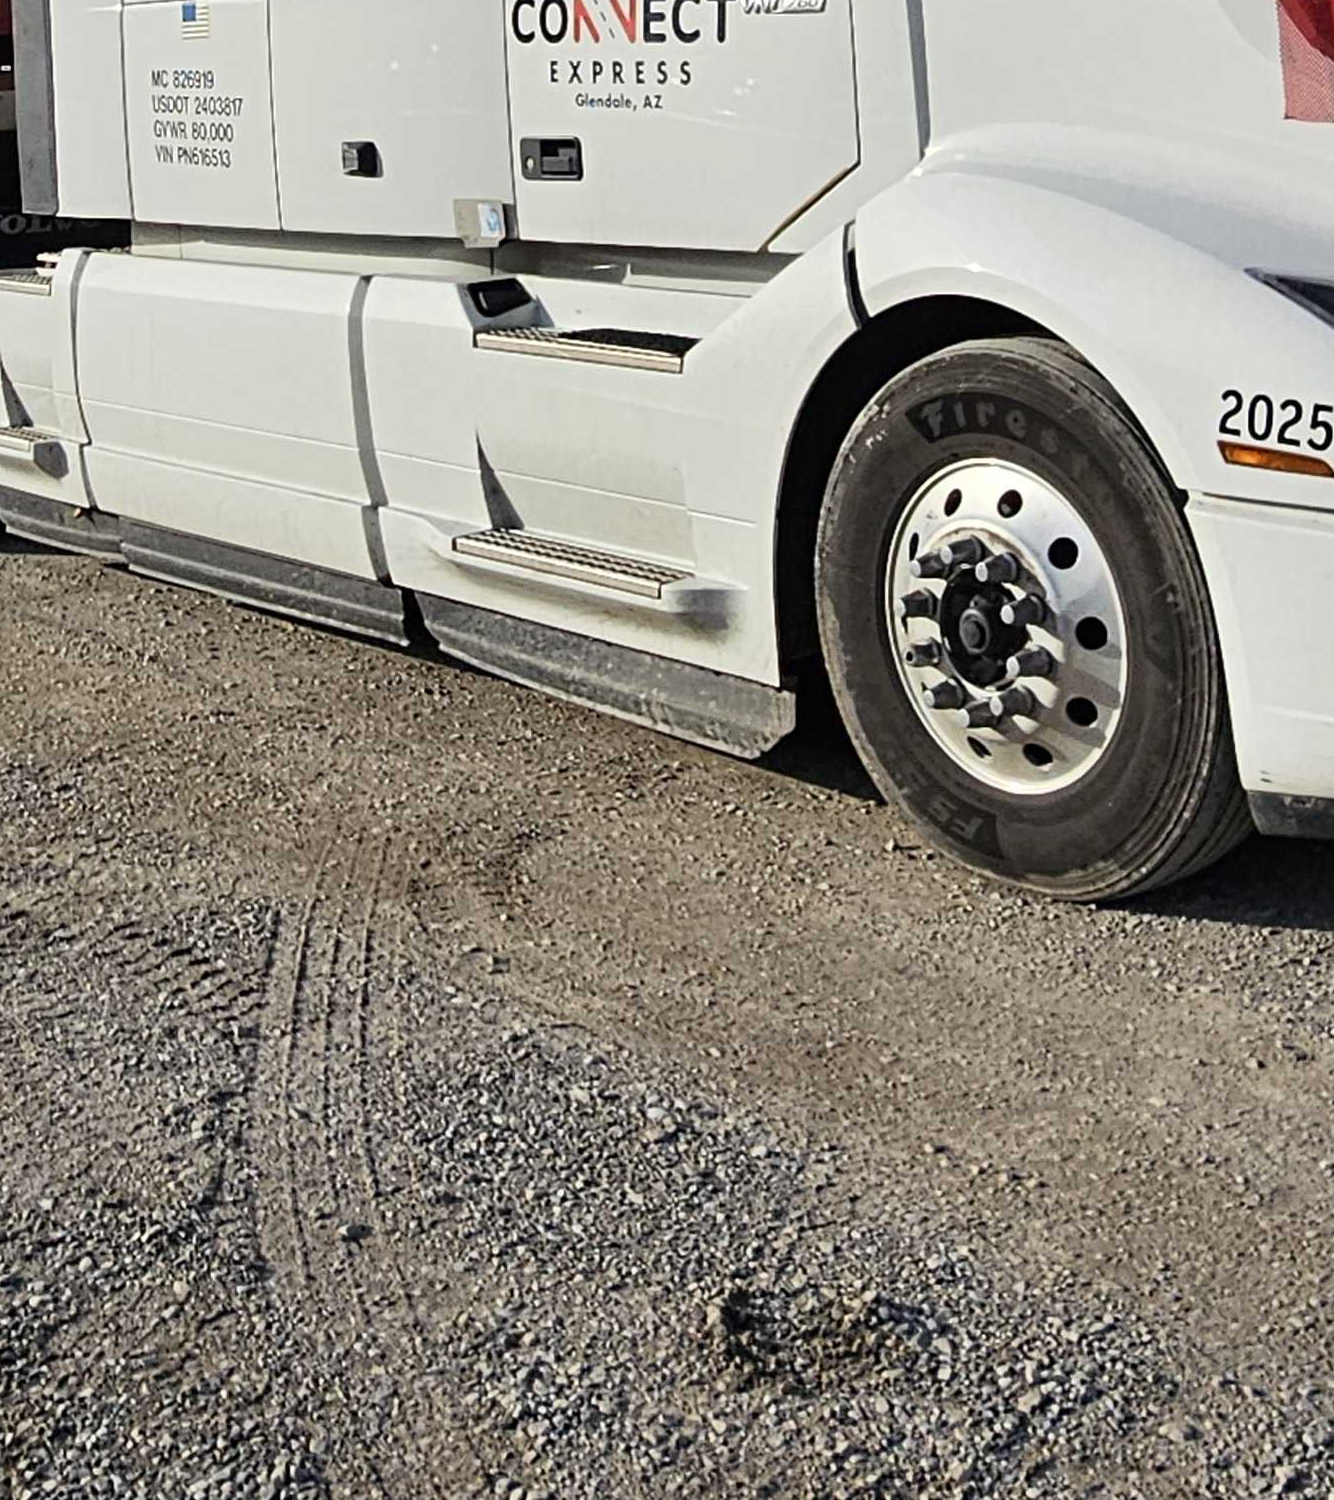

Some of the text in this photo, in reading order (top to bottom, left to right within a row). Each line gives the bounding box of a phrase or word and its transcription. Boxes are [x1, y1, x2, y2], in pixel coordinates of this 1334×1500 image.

[151, 70, 215, 89] MC 826919
[549, 60, 692, 85] EXPRESS
[152, 95, 189, 114] USDOT
[575, 93, 664, 111] Glendale, AZ
[154, 120, 187, 139] GVWR
[155, 145, 173, 164] VIN
[1219, 389, 1334, 451] 2025
